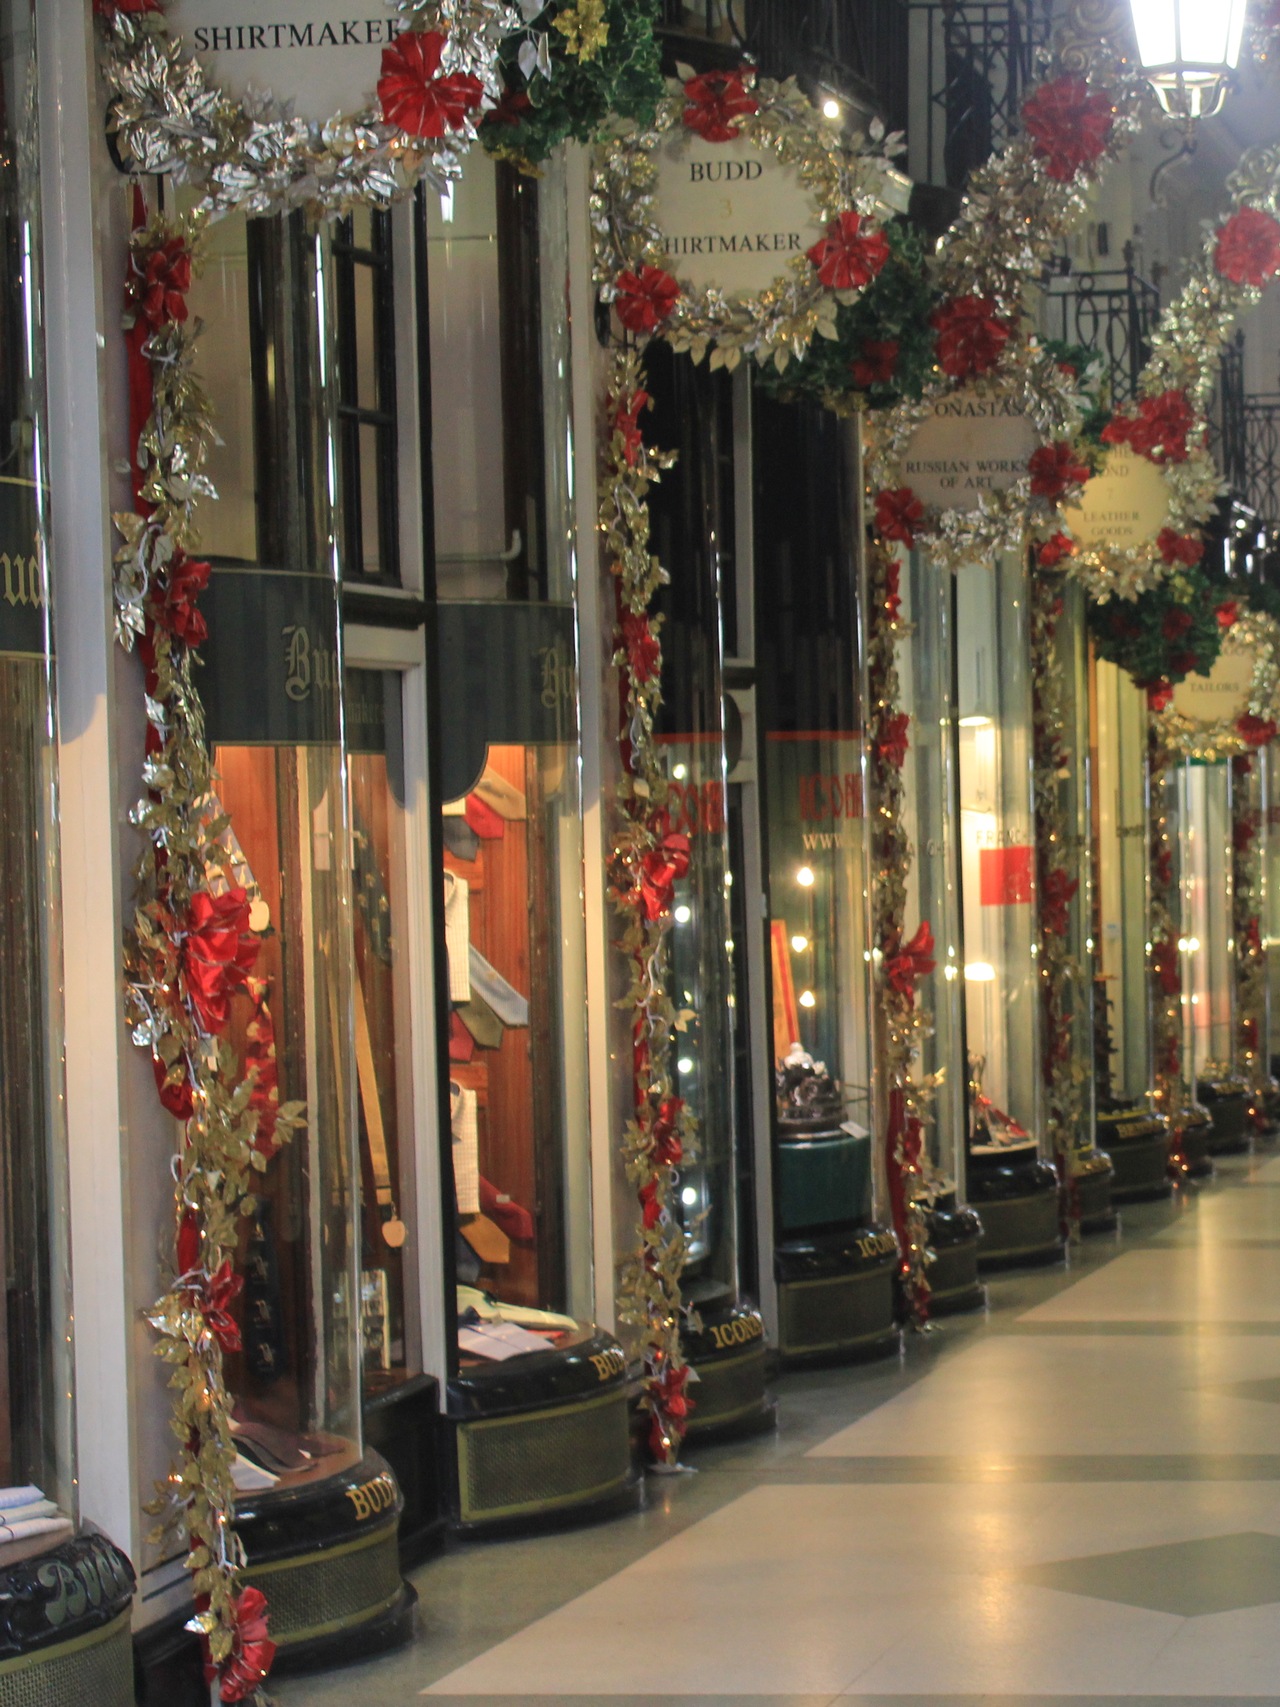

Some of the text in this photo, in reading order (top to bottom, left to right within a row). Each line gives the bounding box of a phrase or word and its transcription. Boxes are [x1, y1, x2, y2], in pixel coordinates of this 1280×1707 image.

[690, 160, 763, 182] BUDD
[664, 233, 801, 255] HIRTMAKER
[906, 459, 1029, 473] RUSSIAN WORKS
[939, 476, 993, 489] OF ART
[1083, 510, 1140, 522] LEATHER
[1091, 526, 1134, 536] GOODS
[1190, 682, 1240, 693] TAILORS
